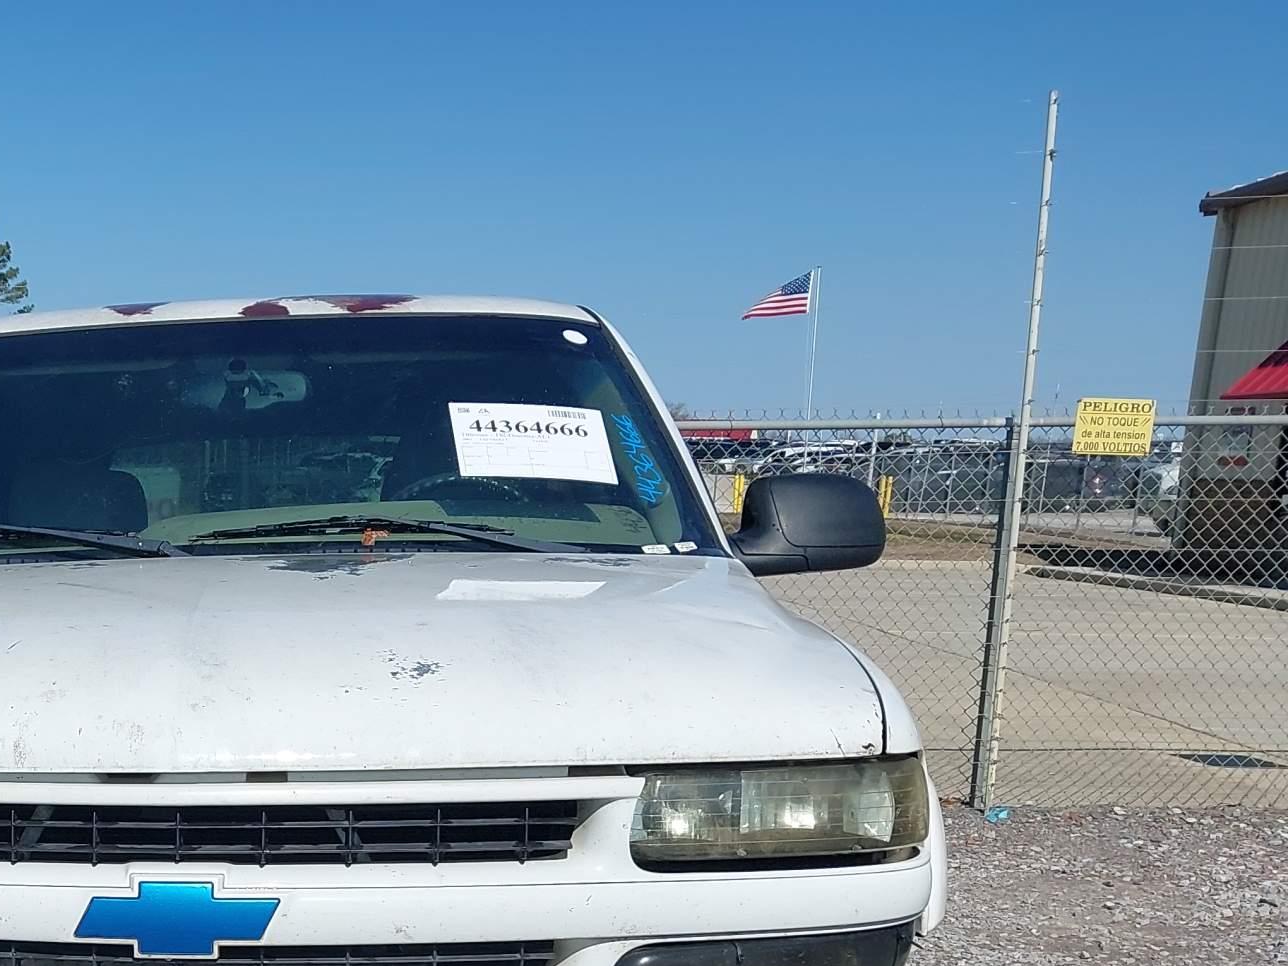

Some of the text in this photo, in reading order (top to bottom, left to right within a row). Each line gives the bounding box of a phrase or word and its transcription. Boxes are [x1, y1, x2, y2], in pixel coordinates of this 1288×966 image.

[1081, 401, 1152, 413] PELIGRO
[1089, 416, 1139, 427] NO TOQUE
[469, 418, 589, 438] 44364666
[1081, 429, 1146, 440] de alta tension
[1102, 442, 1147, 453] VOLTIOS
[611, 413, 663, 503] 44364666
